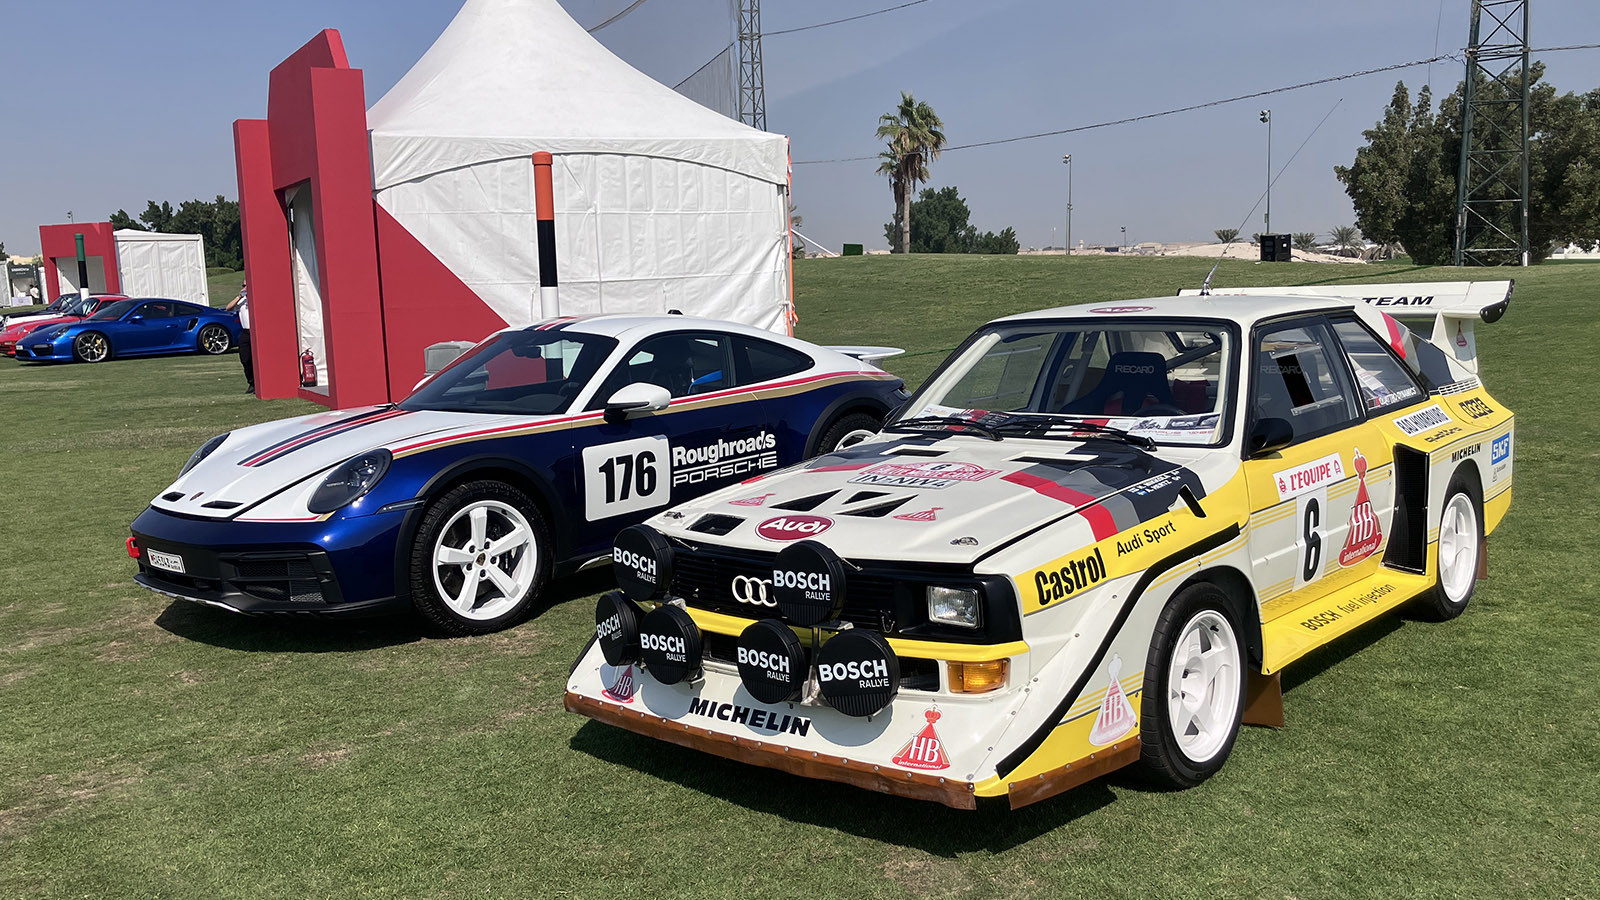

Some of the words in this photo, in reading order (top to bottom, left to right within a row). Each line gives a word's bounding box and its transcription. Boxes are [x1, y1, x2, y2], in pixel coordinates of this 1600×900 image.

[1362, 296, 1434, 306] TEAM
[1115, 365, 1154, 374] RECARO
[1396, 418, 1418, 434] BAD
[672, 430, 777, 467] Roughroads
[1451, 443, 1482, 463] MICHELIN
[1492, 437, 1509, 460] SKF
[598, 450, 657, 504] 176
[673, 455, 778, 488] PORSCHE
[761, 517, 827, 534] Audi
[1351, 501, 1373, 546] HB
[1117, 531, 1144, 557] Audi
[1144, 520, 1176, 549] Sport
[1303, 498, 1322, 583] 6
[1343, 538, 1377, 562] international
[613, 546, 657, 576] BOSCH
[636, 570, 657, 584] RALLYE
[773, 569, 831, 592] BOSCH
[1035, 547, 1107, 606] Castrol
[805, 591, 831, 601] RALLYE
[1300, 609, 1341, 631] BOSCH
[1337, 600, 1361, 614] fuel
[1357, 583, 1396, 606] injection
[596, 612, 621, 639] BOSCH
[640, 632, 686, 654] BOSCH
[666, 653, 687, 663] RALLYE
[737, 646, 790, 673] BOSCH
[818, 658, 888, 682] BOSCH
[613, 675, 633, 697] HB
[766, 670, 791, 683] RALLYE
[859, 677, 890, 689] RALLYE
[689, 697, 811, 738] MICHELIN
[1101, 693, 1124, 729] HB
[908, 735, 940, 763] HB
[898, 759, 942, 769] international
